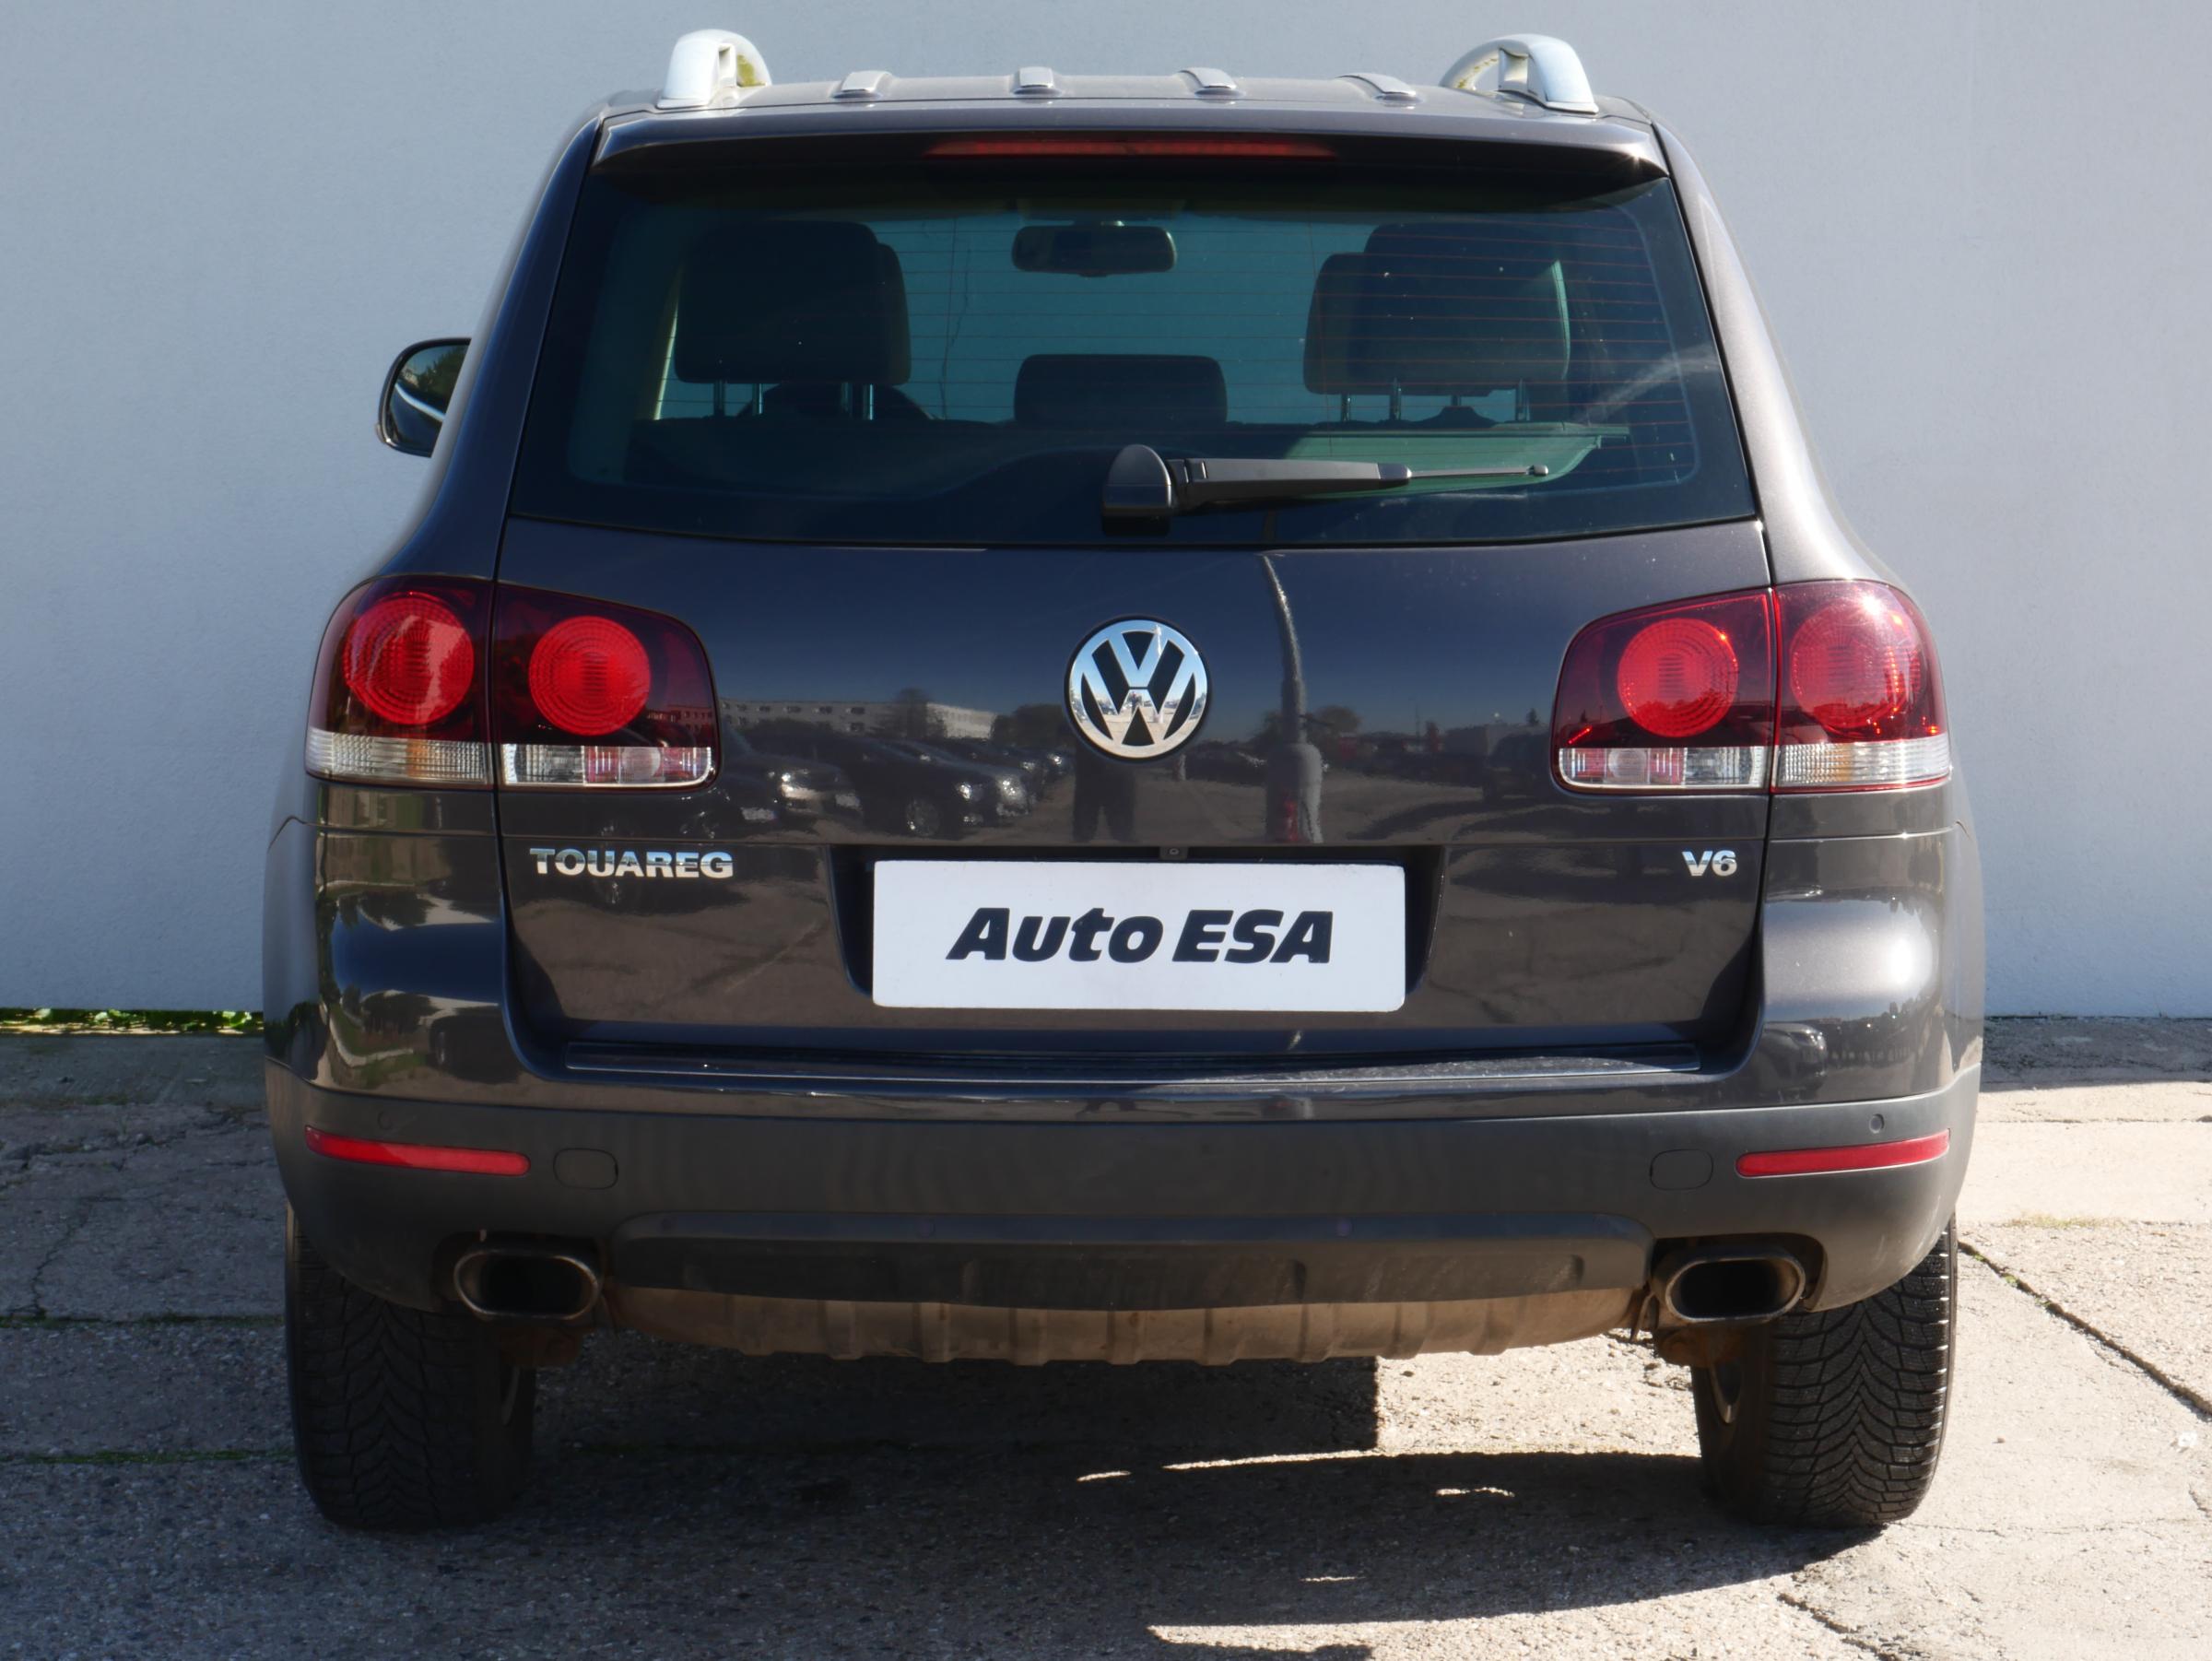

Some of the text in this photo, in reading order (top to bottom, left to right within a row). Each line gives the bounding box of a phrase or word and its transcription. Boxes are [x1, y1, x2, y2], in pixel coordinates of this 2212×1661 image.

[1069, 618, 1208, 759] VW
[529, 847, 735, 879] TOUAREG
[1681, 849, 1738, 878] V6
[946, 906, 1334, 964] Auto ESA
